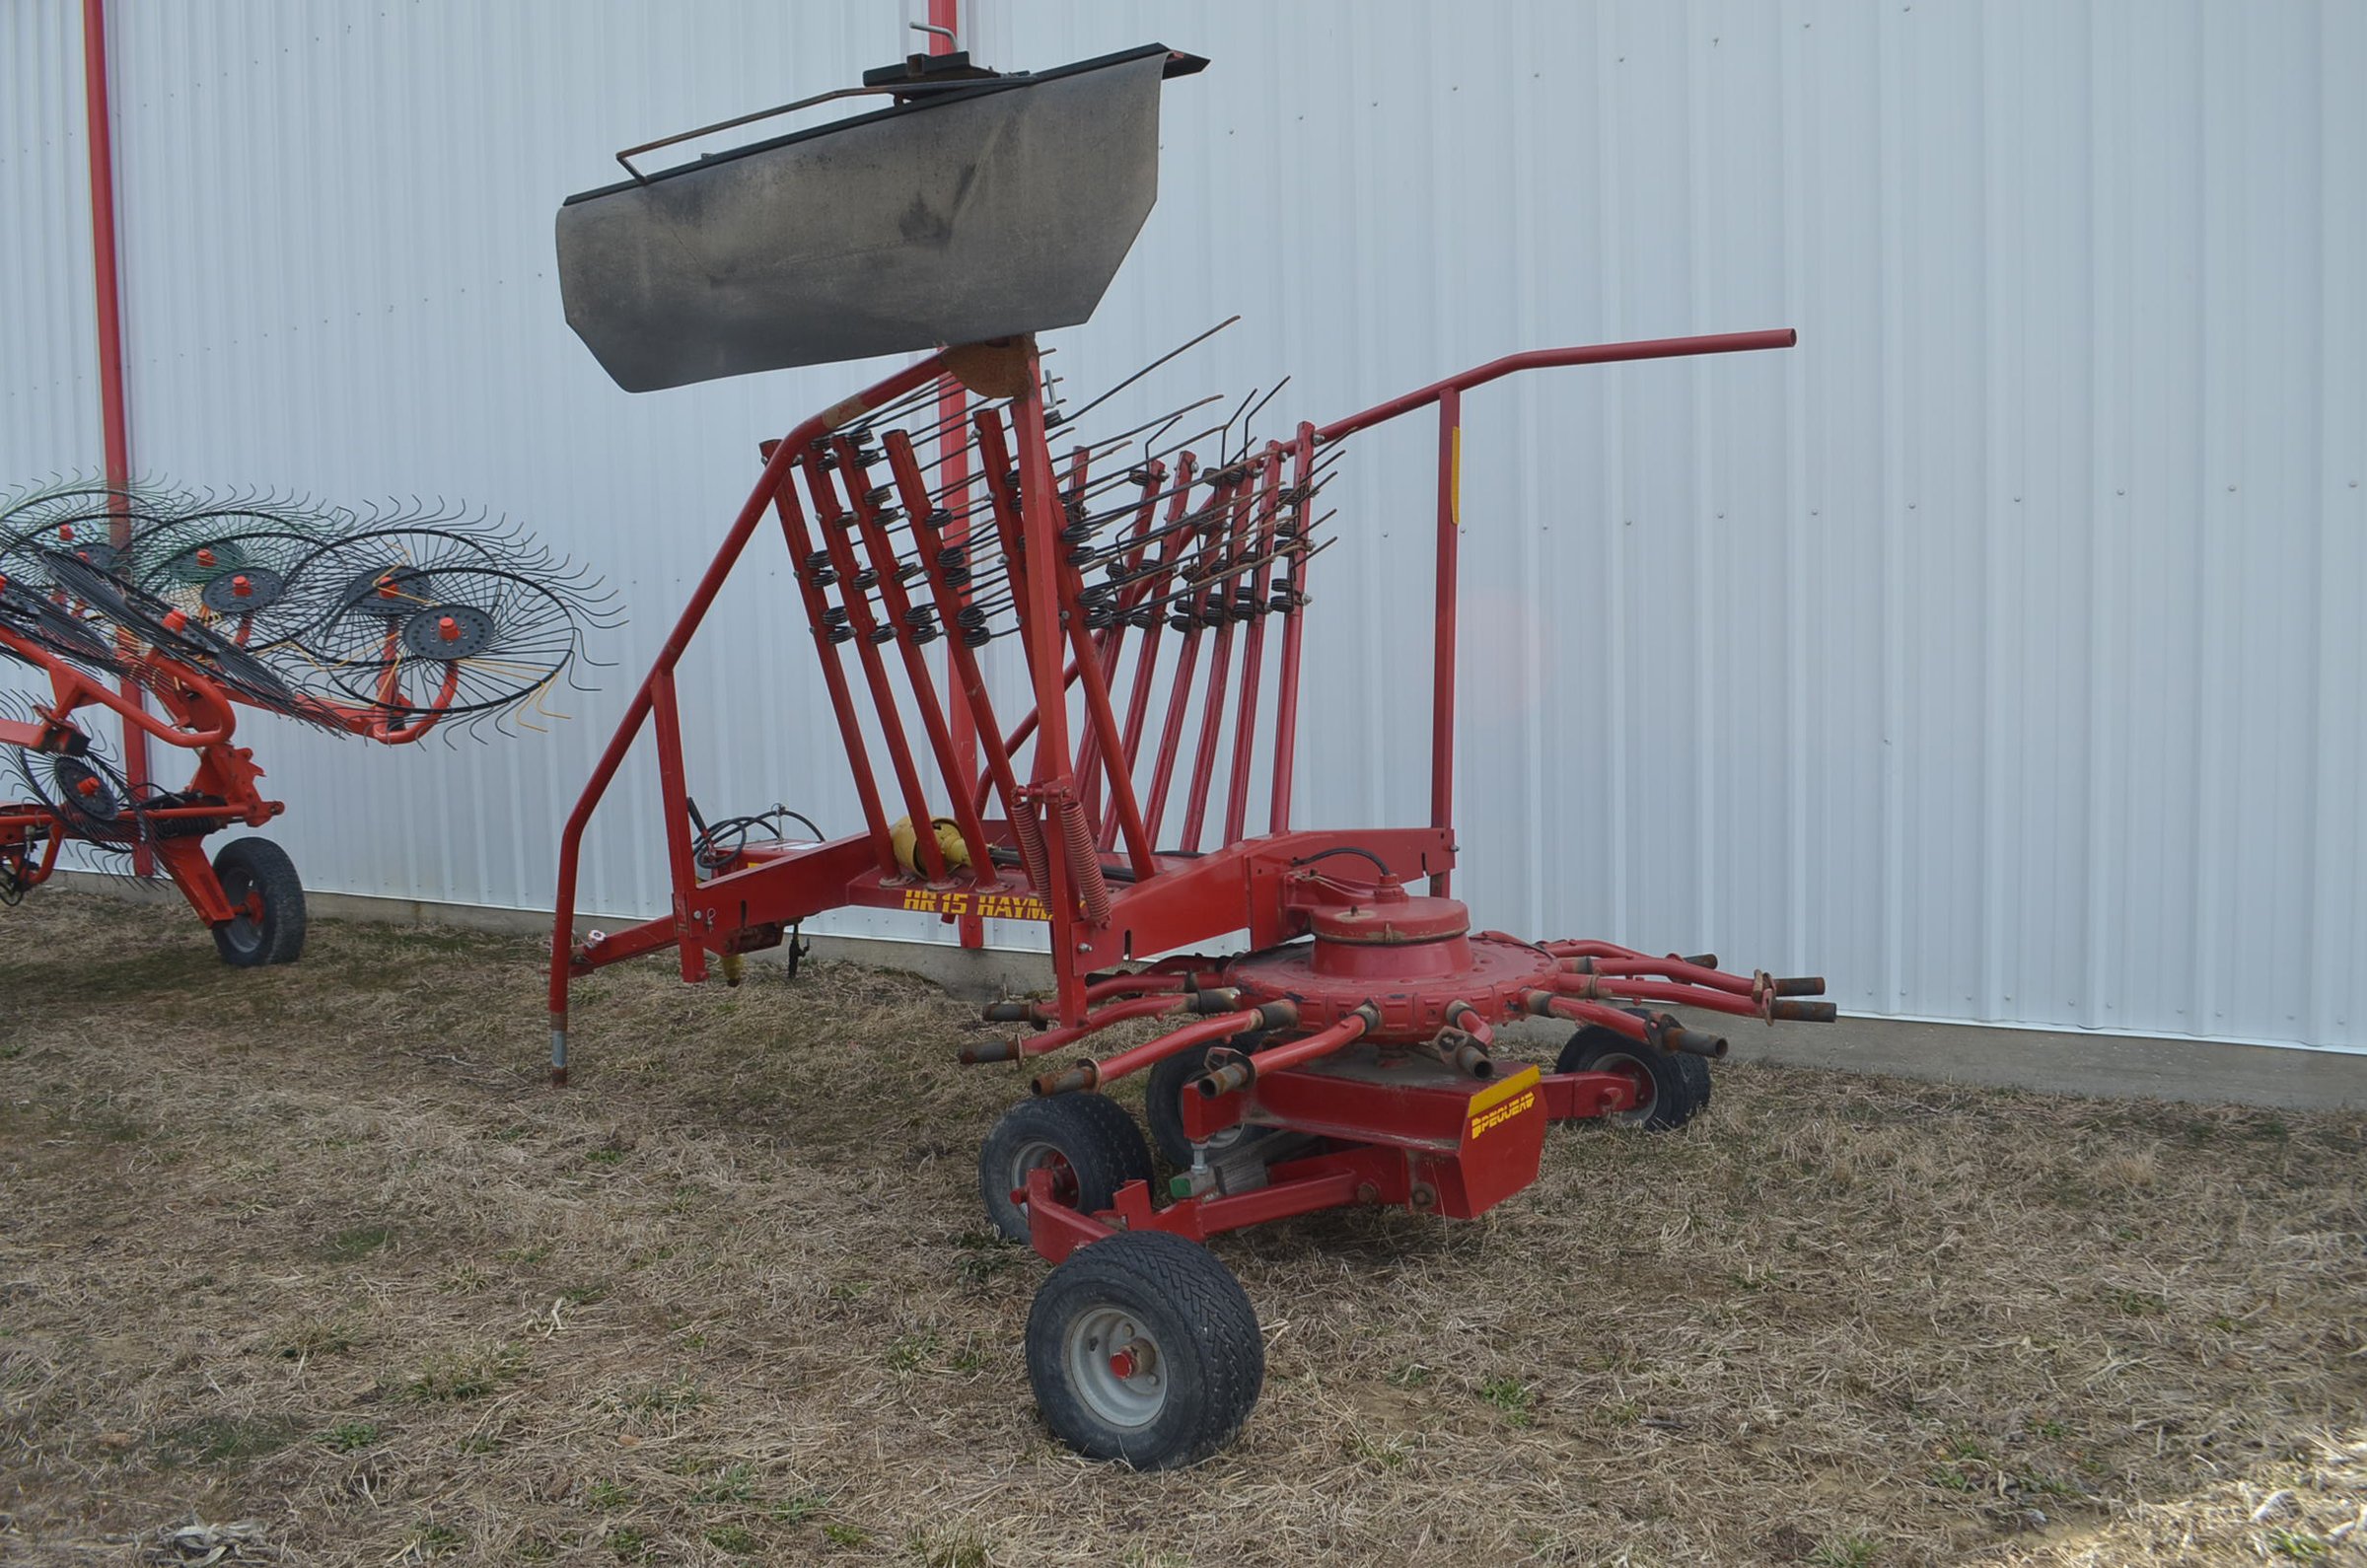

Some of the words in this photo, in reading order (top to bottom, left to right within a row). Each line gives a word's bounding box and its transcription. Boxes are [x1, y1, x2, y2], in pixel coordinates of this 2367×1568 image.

[904, 890, 936, 911] HR
[942, 892, 968, 914] 15
[977, 895, 1053, 920] HAYM
